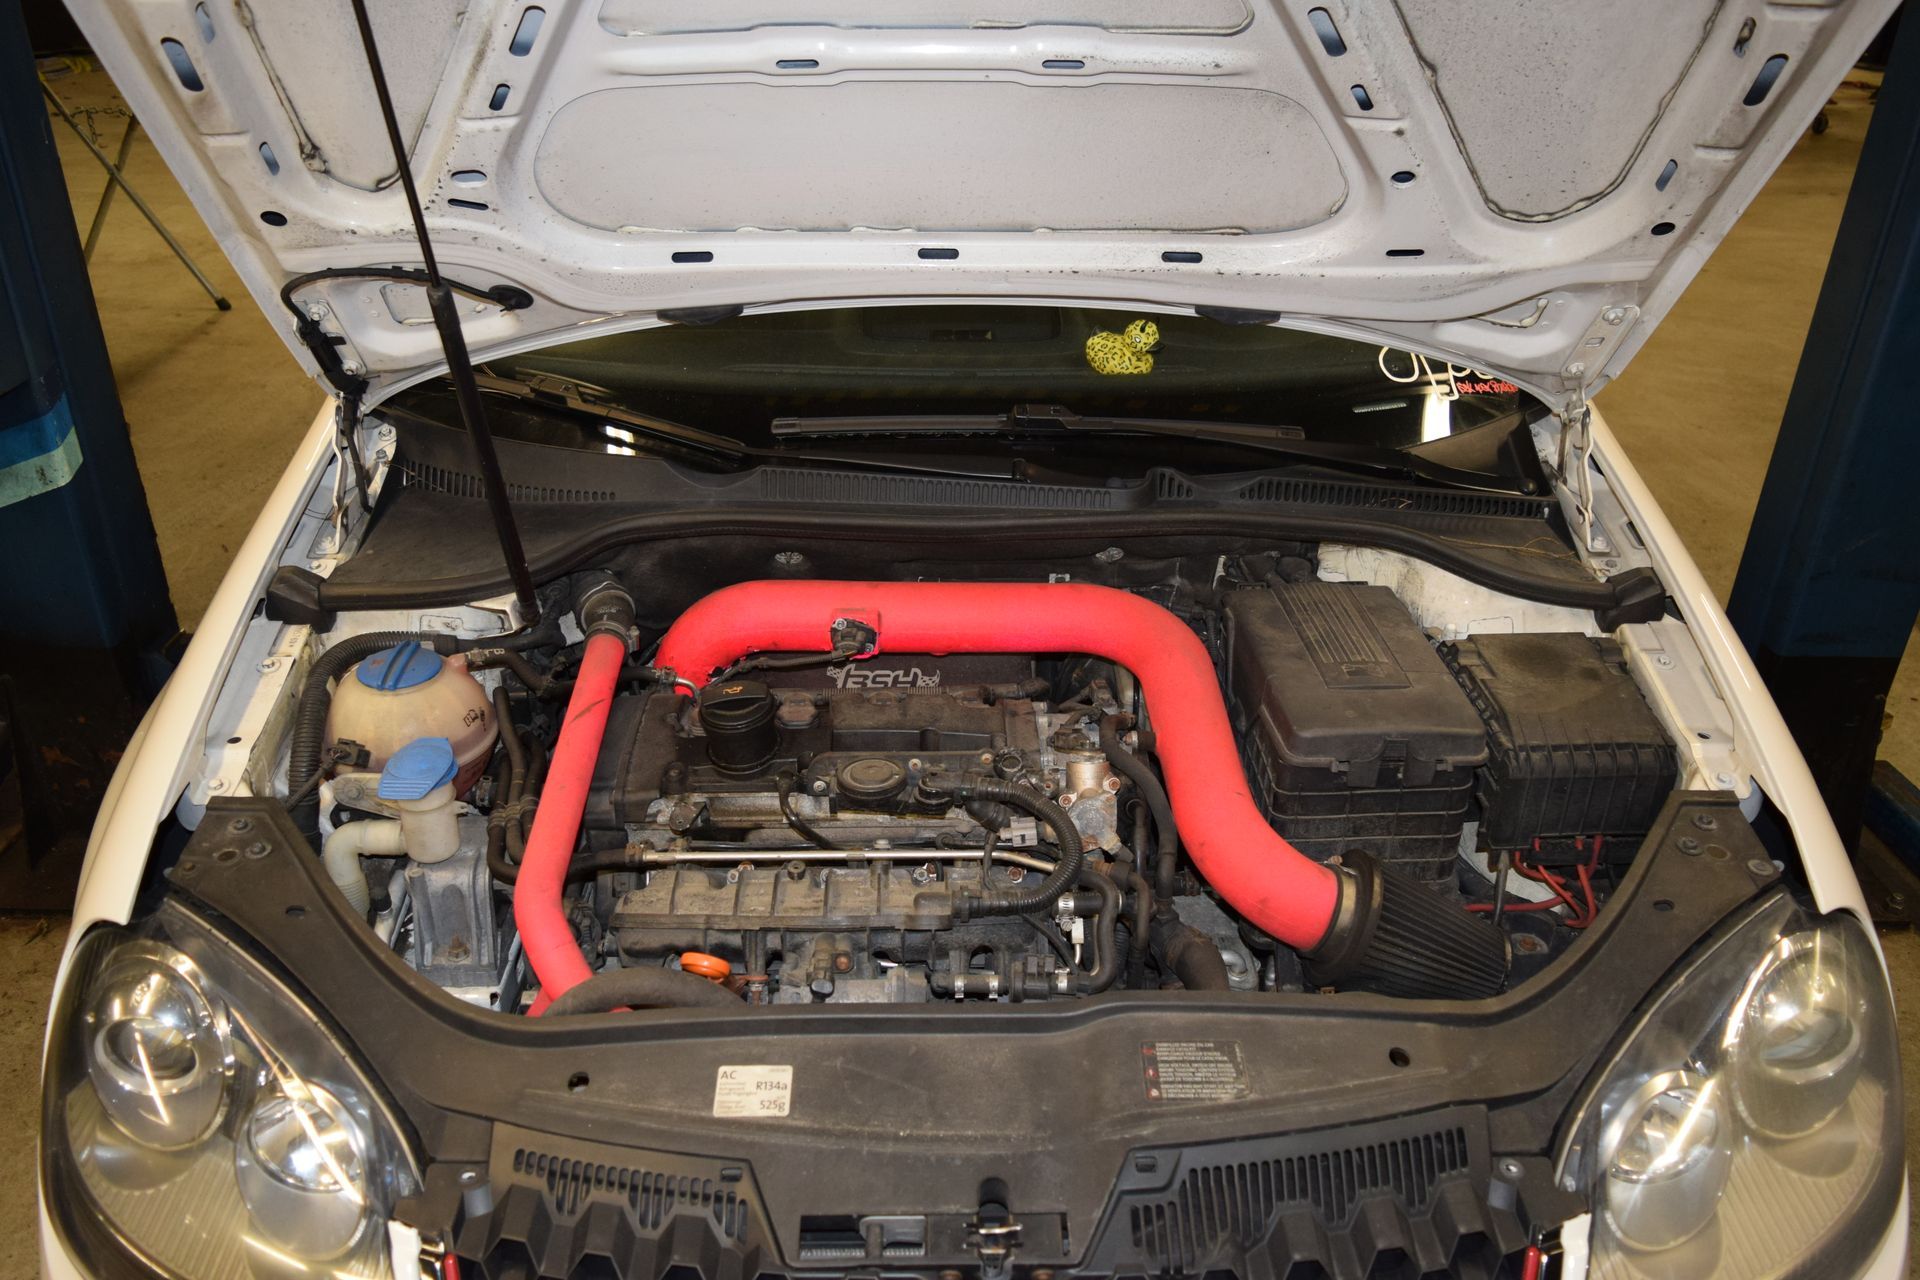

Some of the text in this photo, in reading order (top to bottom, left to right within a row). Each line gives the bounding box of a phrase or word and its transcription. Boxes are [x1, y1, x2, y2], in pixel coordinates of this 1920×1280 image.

[720, 1070, 737, 1079] AC
[756, 1081, 788, 1091] R134a
[760, 1100, 786, 1112] 525g
